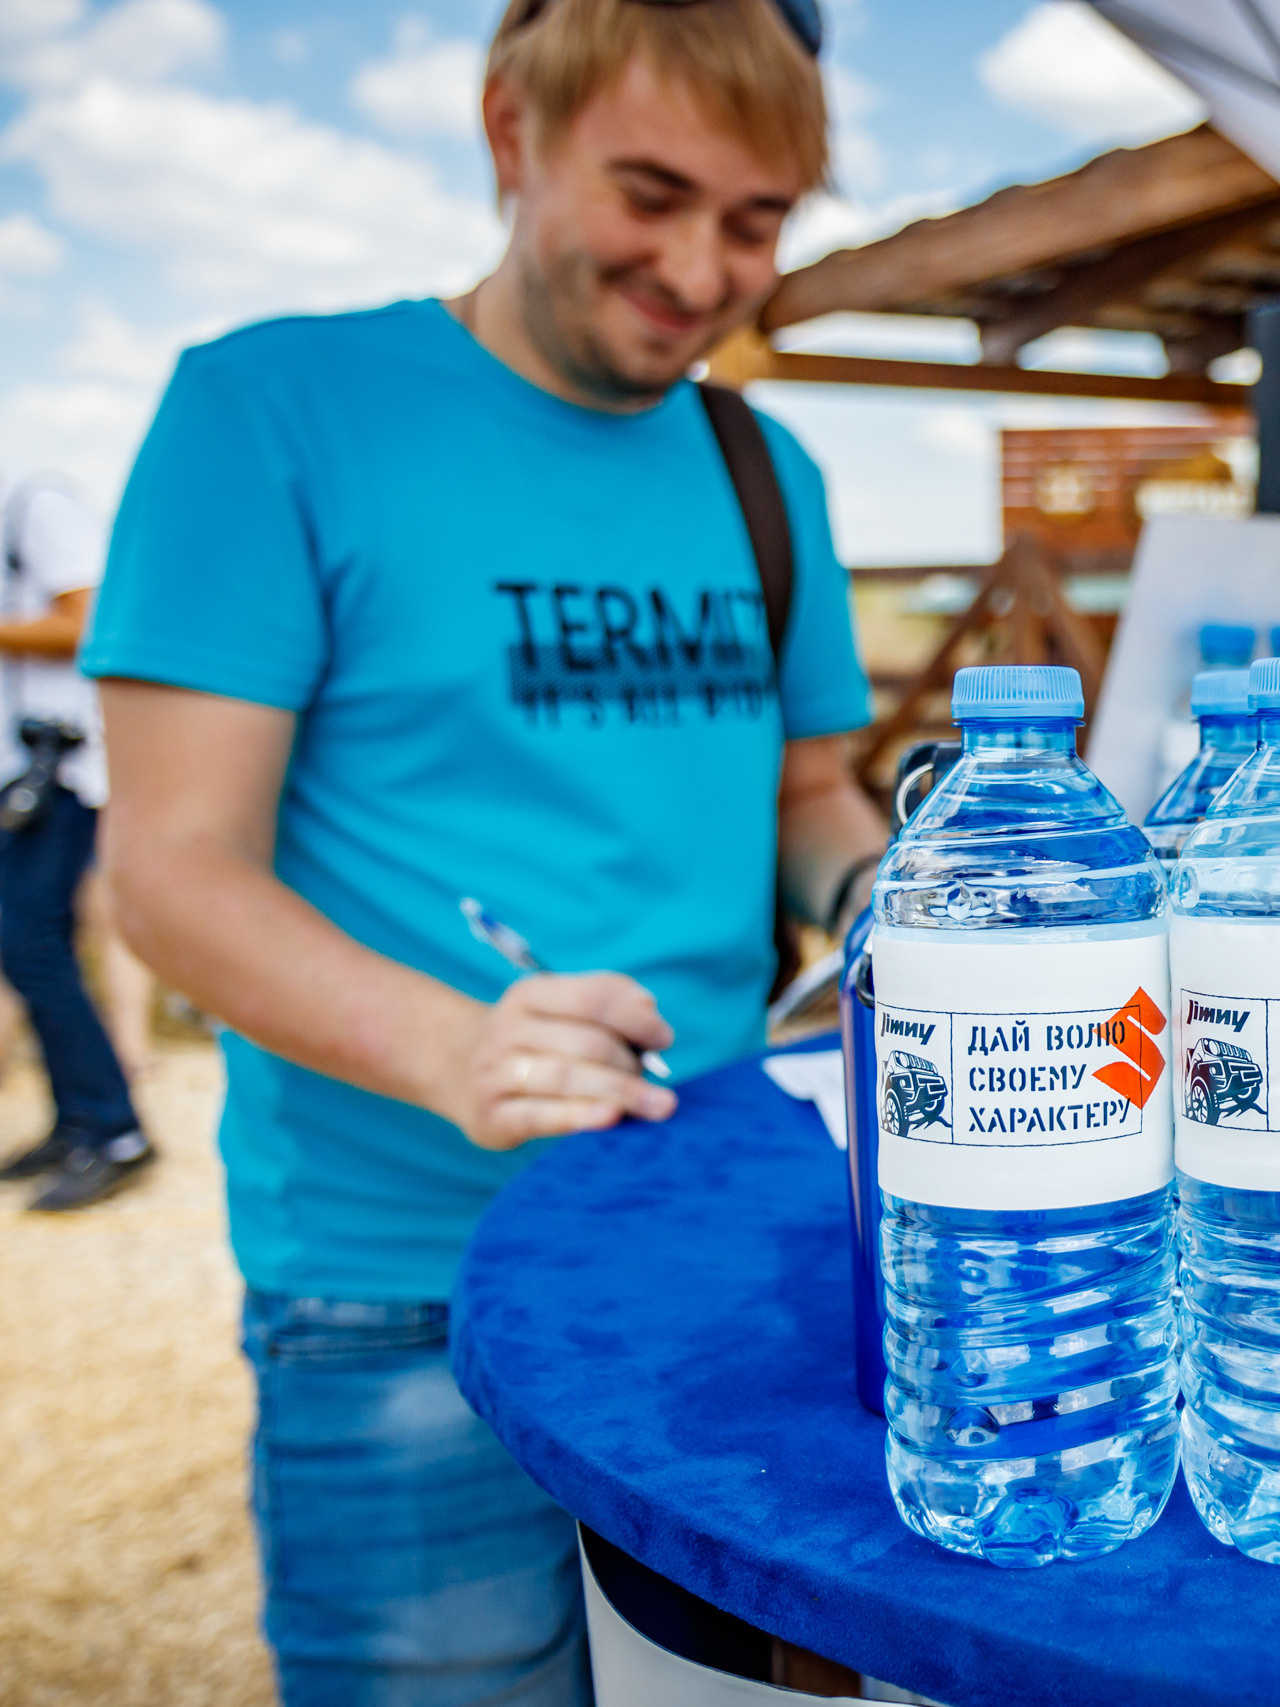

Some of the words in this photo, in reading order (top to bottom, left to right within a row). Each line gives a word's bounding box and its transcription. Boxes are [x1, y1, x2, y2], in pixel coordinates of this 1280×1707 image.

[880, 1012, 936, 1045] Jimny
[1187, 999, 1250, 1033] Jimny
[967, 1020, 1030, 1056] ДАЙ
[1046, 1020, 1126, 1051] ВОЛЮ
[968, 1063, 1087, 1092] СВОЕМУ
[968, 1098, 1131, 1133] ХАРАКТЕРУ
